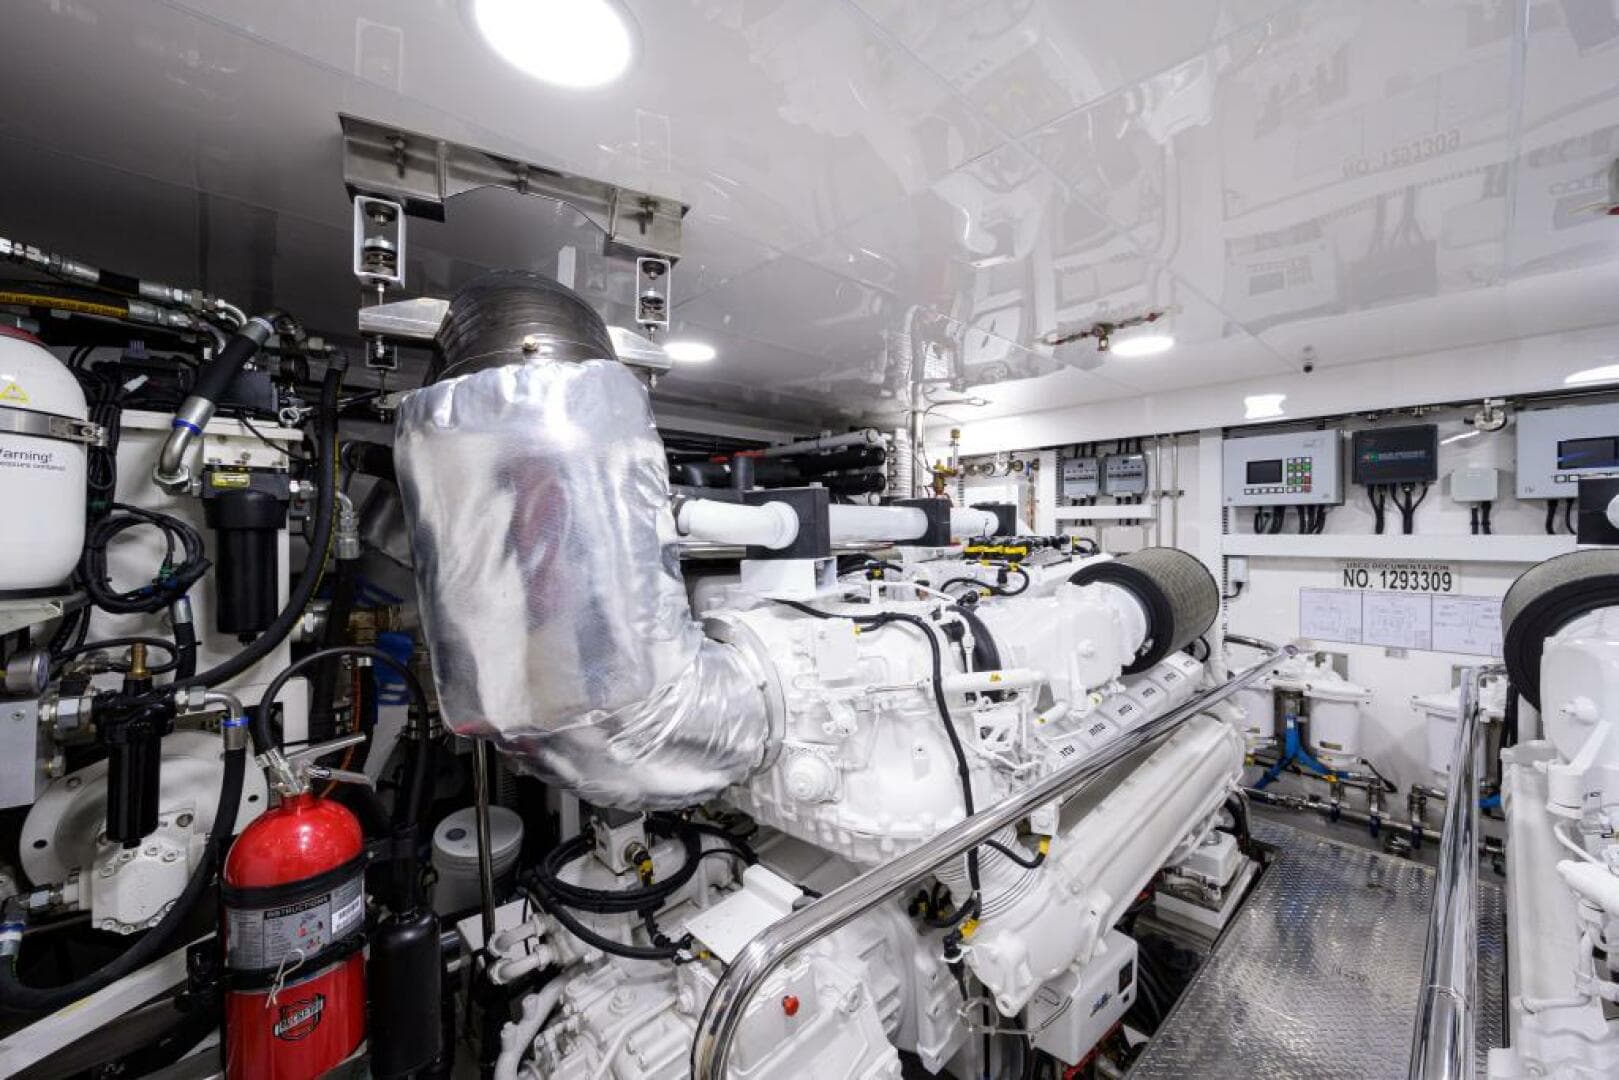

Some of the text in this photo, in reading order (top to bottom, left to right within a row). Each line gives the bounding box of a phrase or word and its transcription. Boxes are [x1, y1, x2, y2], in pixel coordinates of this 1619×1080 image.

[0, 449, 53, 464] arning!
[1343, 568, 1452, 592] NO. 1293309
